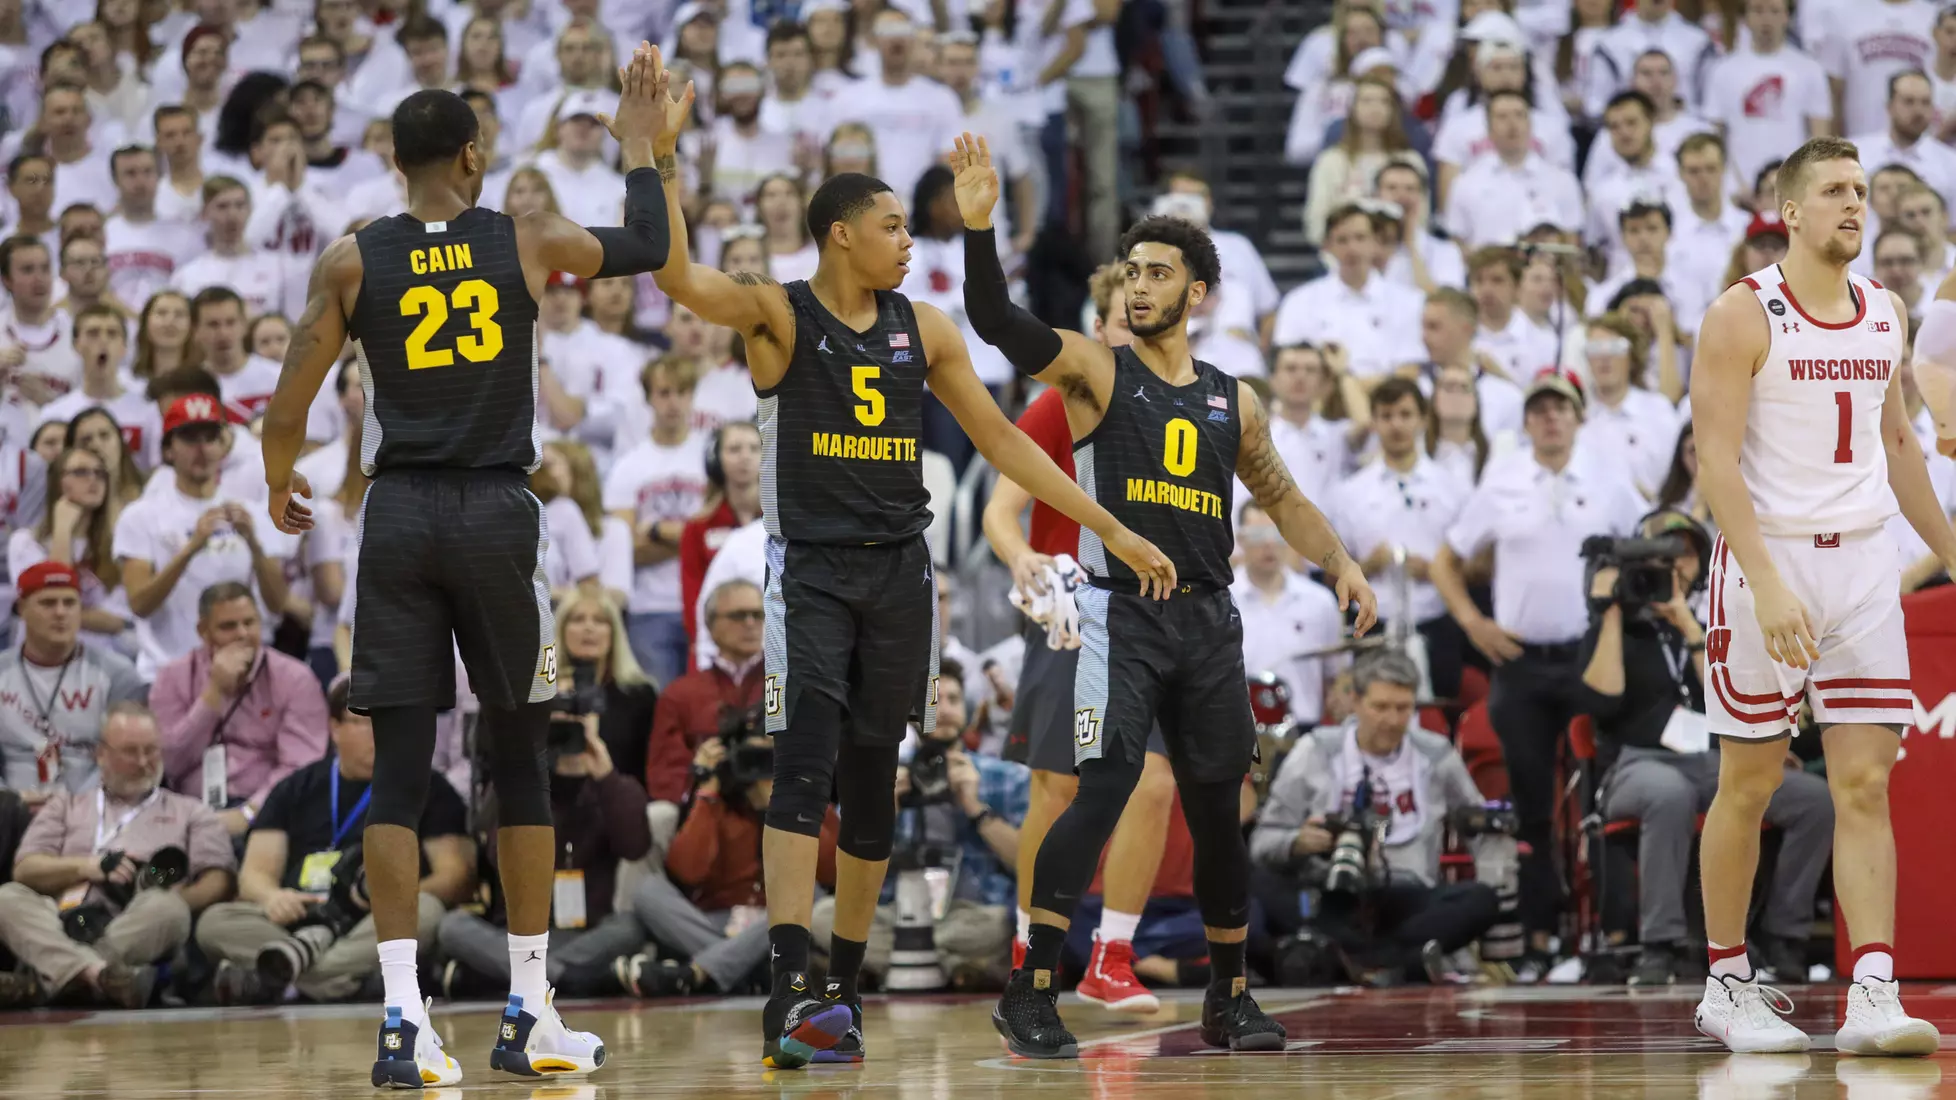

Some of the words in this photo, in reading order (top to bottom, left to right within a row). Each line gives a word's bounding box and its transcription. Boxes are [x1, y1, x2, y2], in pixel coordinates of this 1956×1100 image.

[410, 243, 473, 275] CAIN
[399, 279, 504, 370] 23
[1864, 321, 1890, 333] BIG
[1788, 359, 1891, 381] WISCONSIN
[185, 396, 213, 419] W
[851, 366, 886, 426] 5
[1834, 392, 1853, 463] 1
[812, 432, 916, 461] MARQUETTE
[1163, 418, 1198, 477] 0
[1126, 478, 1222, 520] MARQUETTE
[1706, 629, 1732, 665] W
[61, 685, 92, 711] W
[1075, 708, 1099, 747] MU
[384, 1032, 402, 1050] MU
[501, 1022, 517, 1040] MU
